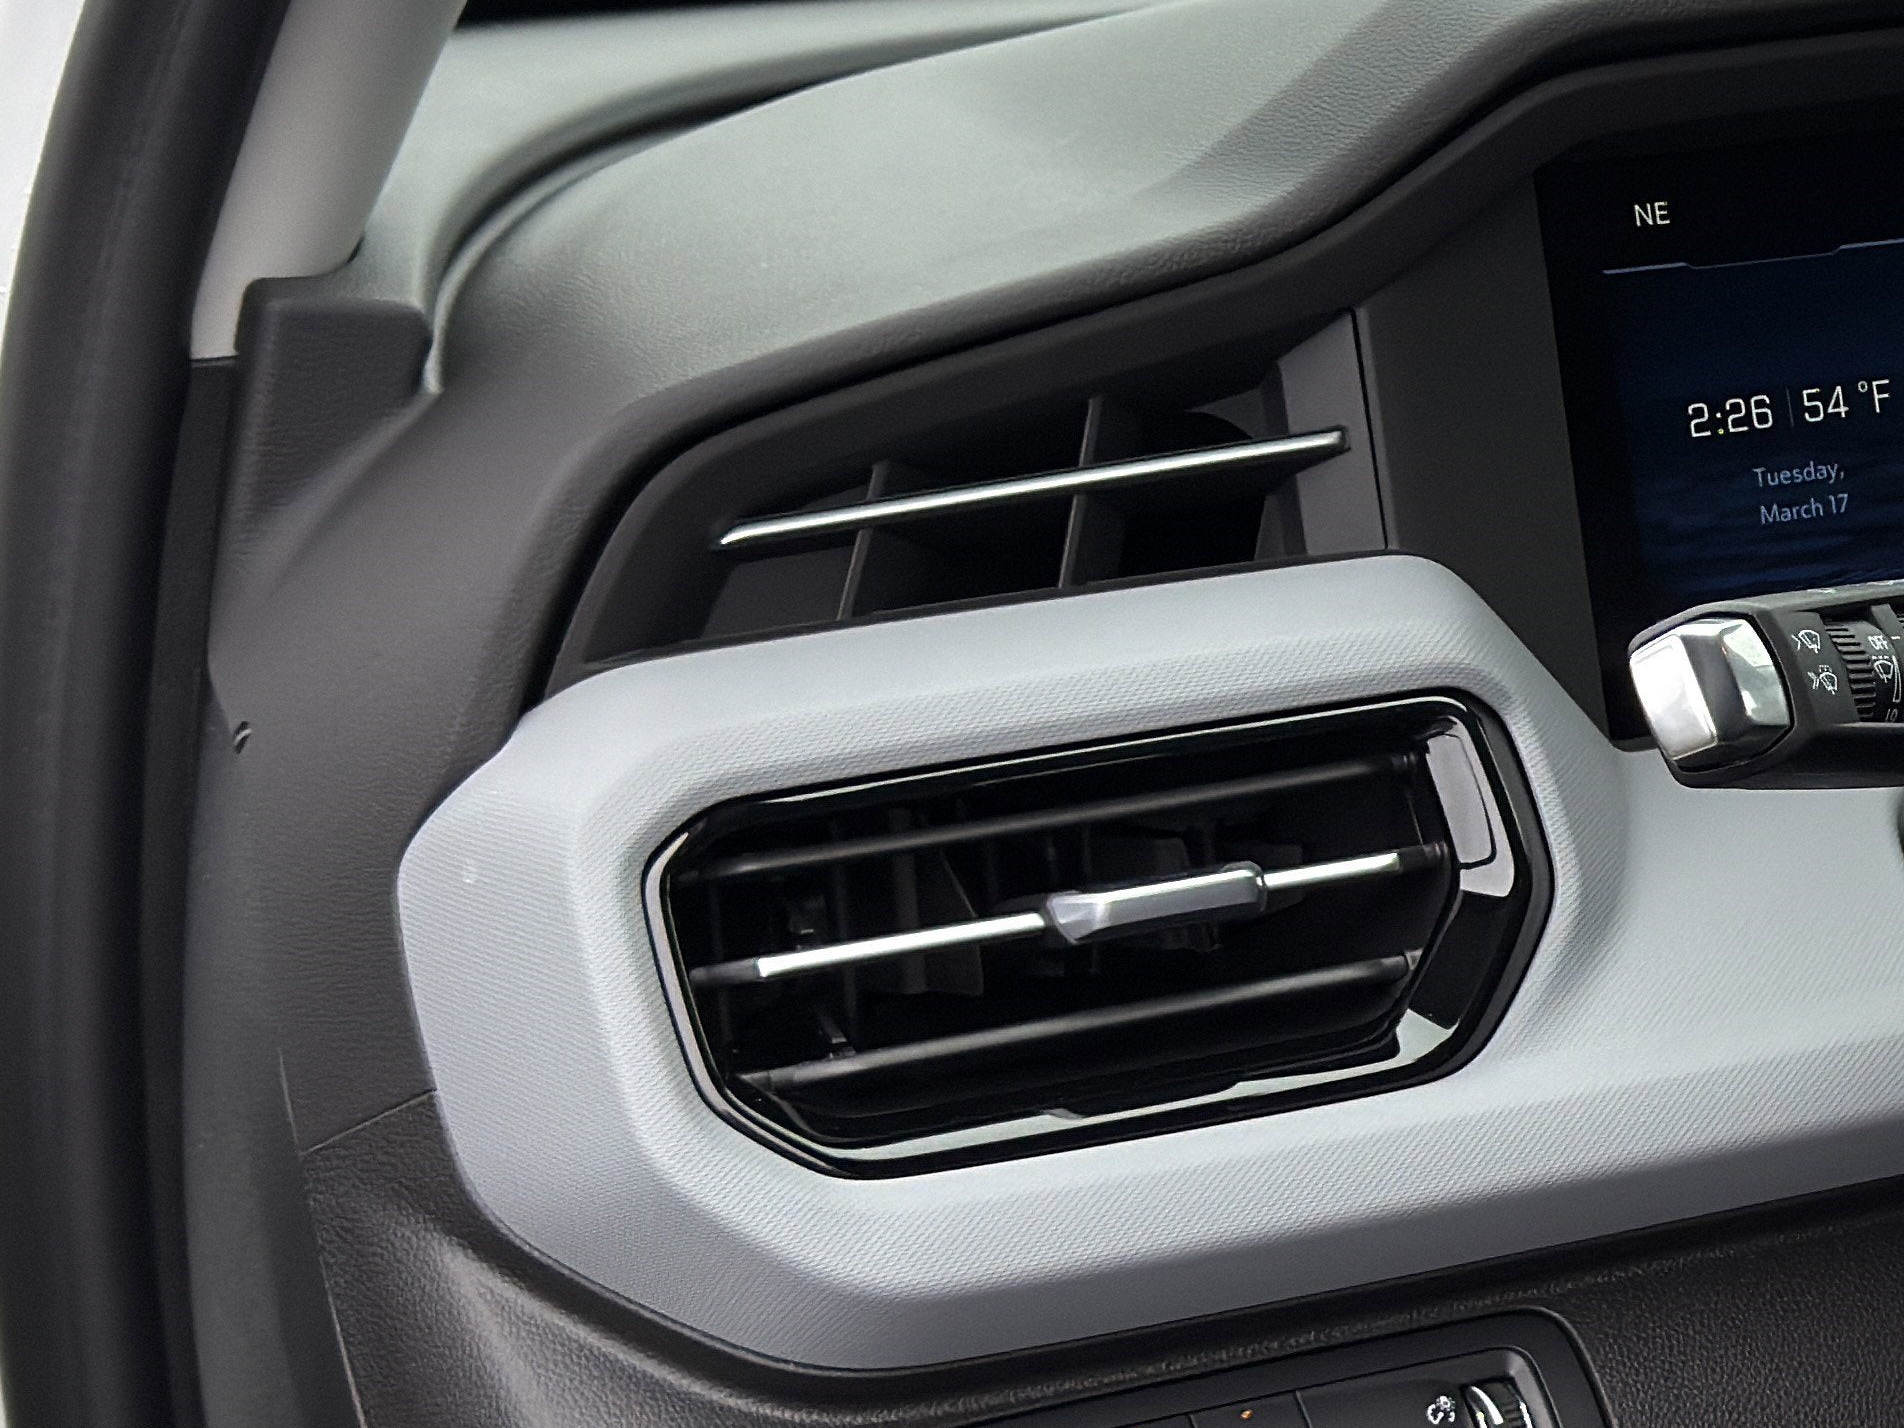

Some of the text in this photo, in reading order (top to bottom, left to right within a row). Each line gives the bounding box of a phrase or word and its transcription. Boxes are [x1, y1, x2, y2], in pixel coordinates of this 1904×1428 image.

[1634, 201, 1671, 227] NE
[1687, 394, 1774, 438] 2:26
[1802, 385, 1850, 423] 54
[1752, 460, 1846, 488] Tuesday,
[1760, 493, 1849, 526] March 17
